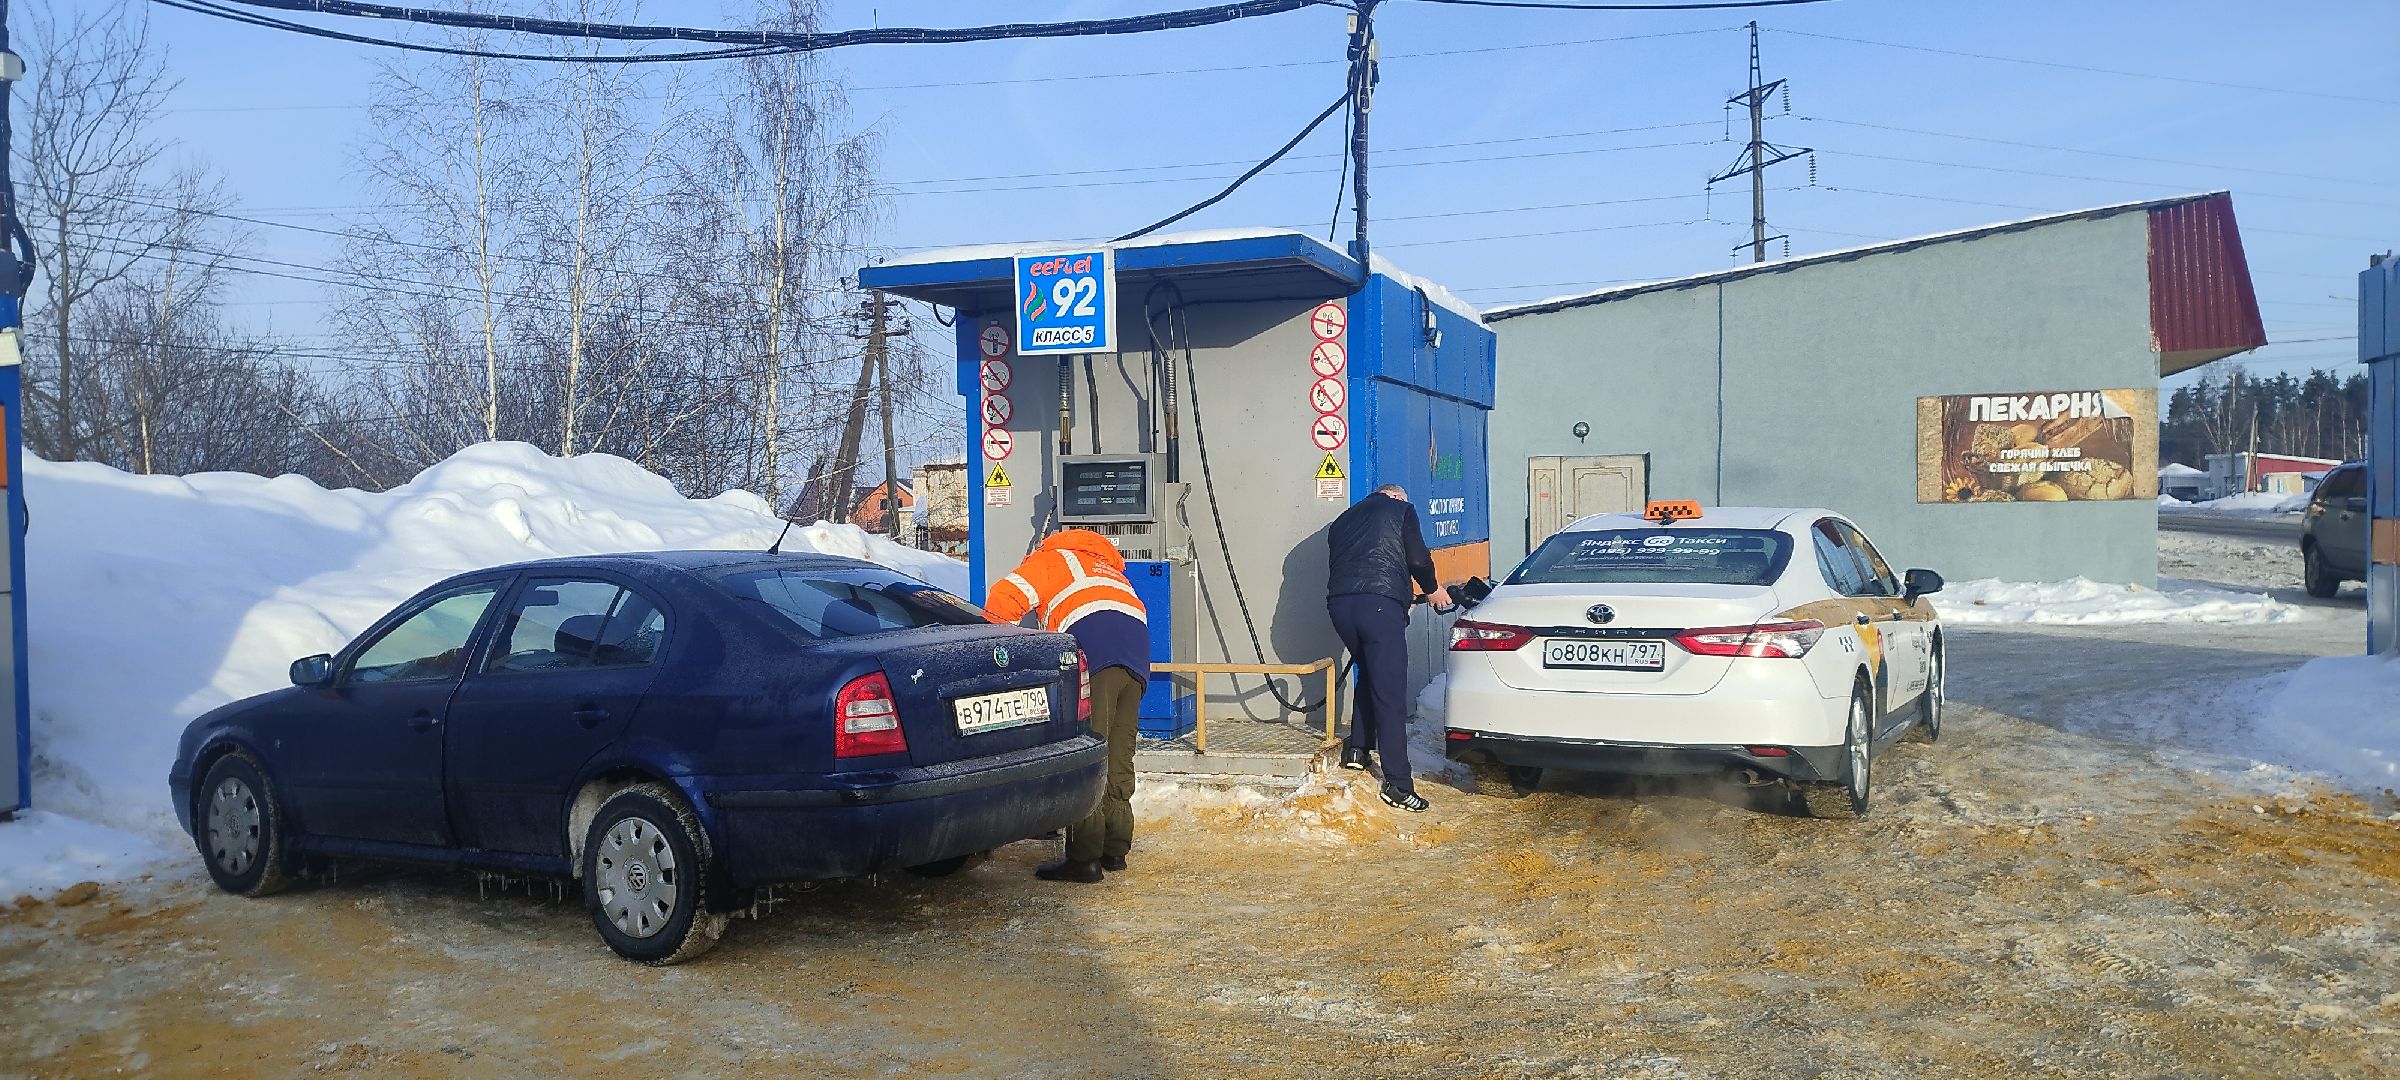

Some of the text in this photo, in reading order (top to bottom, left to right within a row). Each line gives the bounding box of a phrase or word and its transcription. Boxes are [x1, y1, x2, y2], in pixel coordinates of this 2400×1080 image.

[1052, 276, 1097, 318] 92
[1035, 329, 1092, 343] КЛАСС 5
[2000, 446, 2081, 459] ГОРЯЧИЙ ХЛЕБ
[1989, 461, 2092, 473] СВЕЖАЯ ВЫПЕЧКА
[1580, 539, 1641, 548] Яндекс
[1150, 565, 1162, 577] 95
[1628, 644, 1658, 659] 797
